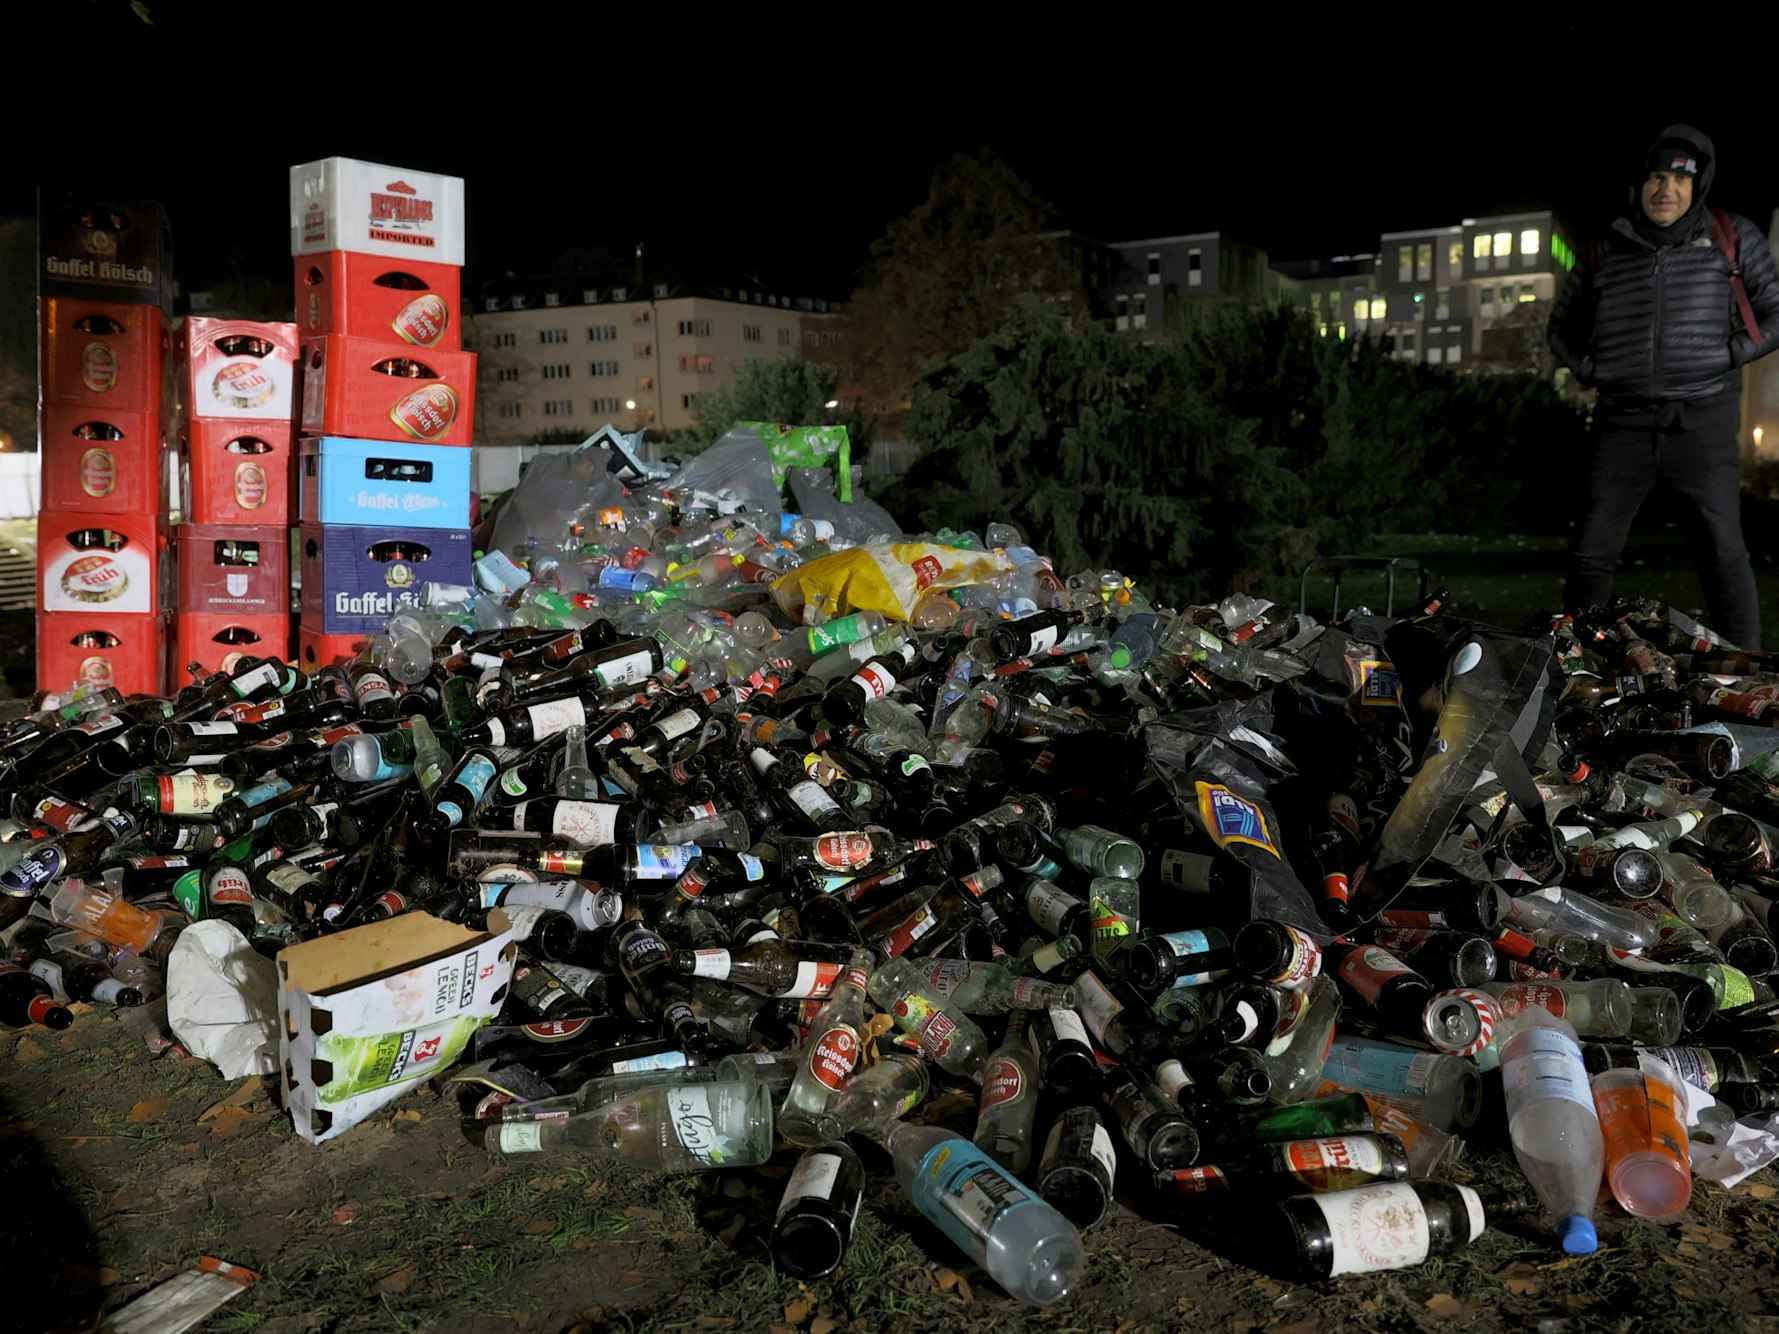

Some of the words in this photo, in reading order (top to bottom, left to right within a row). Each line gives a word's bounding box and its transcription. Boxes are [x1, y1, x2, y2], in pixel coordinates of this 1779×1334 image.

[370, 229, 434, 246] IMPORTED
[47, 256, 96, 278] Gaffel
[100, 262, 153, 284] Kölsch
[357, 491, 400, 510] Gaffel
[335, 591, 394, 616] Gaffel
